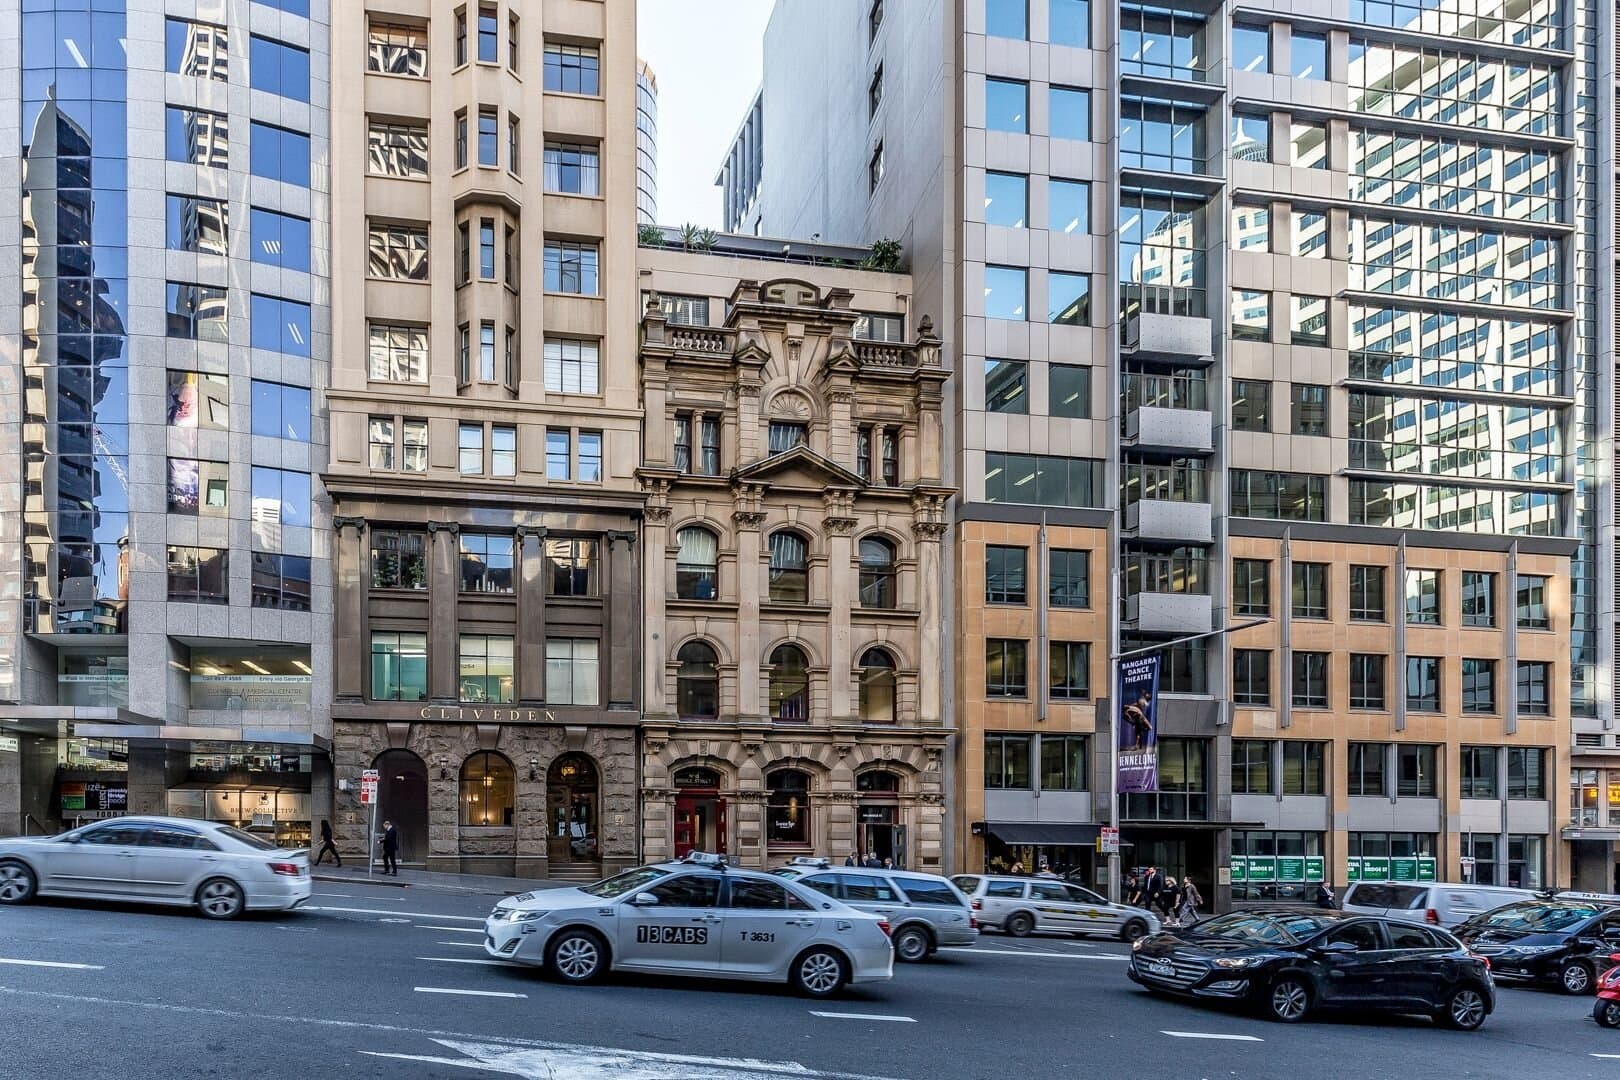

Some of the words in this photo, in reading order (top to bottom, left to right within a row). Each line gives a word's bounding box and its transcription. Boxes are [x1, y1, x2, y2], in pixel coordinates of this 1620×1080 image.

[1121, 656, 1157, 670] BANGARRA
[1127, 665, 1150, 676] DANCE
[1125, 673, 1152, 684] THEATRE
[278, 688, 303, 696] CENTRE
[420, 707, 556, 721] CLIVEDEN
[740, 931, 748, 941] T
[750, 931, 776, 943] 3631
